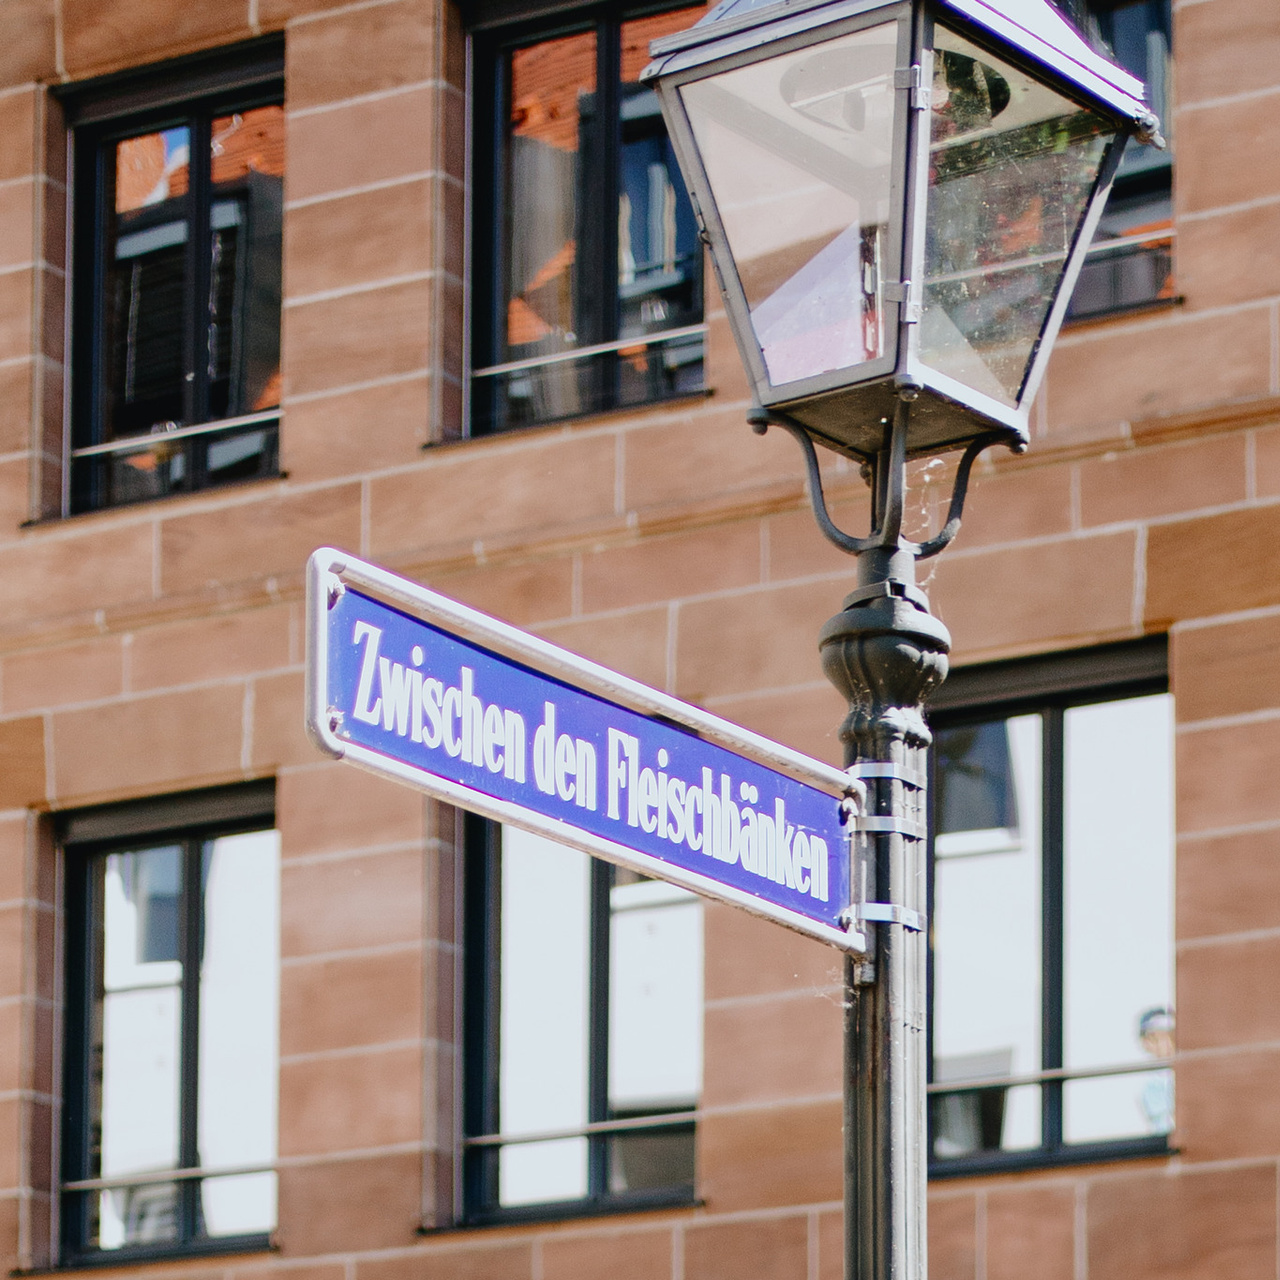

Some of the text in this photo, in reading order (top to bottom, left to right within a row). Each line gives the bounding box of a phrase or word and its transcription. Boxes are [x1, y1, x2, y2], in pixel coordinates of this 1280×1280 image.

[353, 620, 829, 902] Zwischen den Fleischbänken
